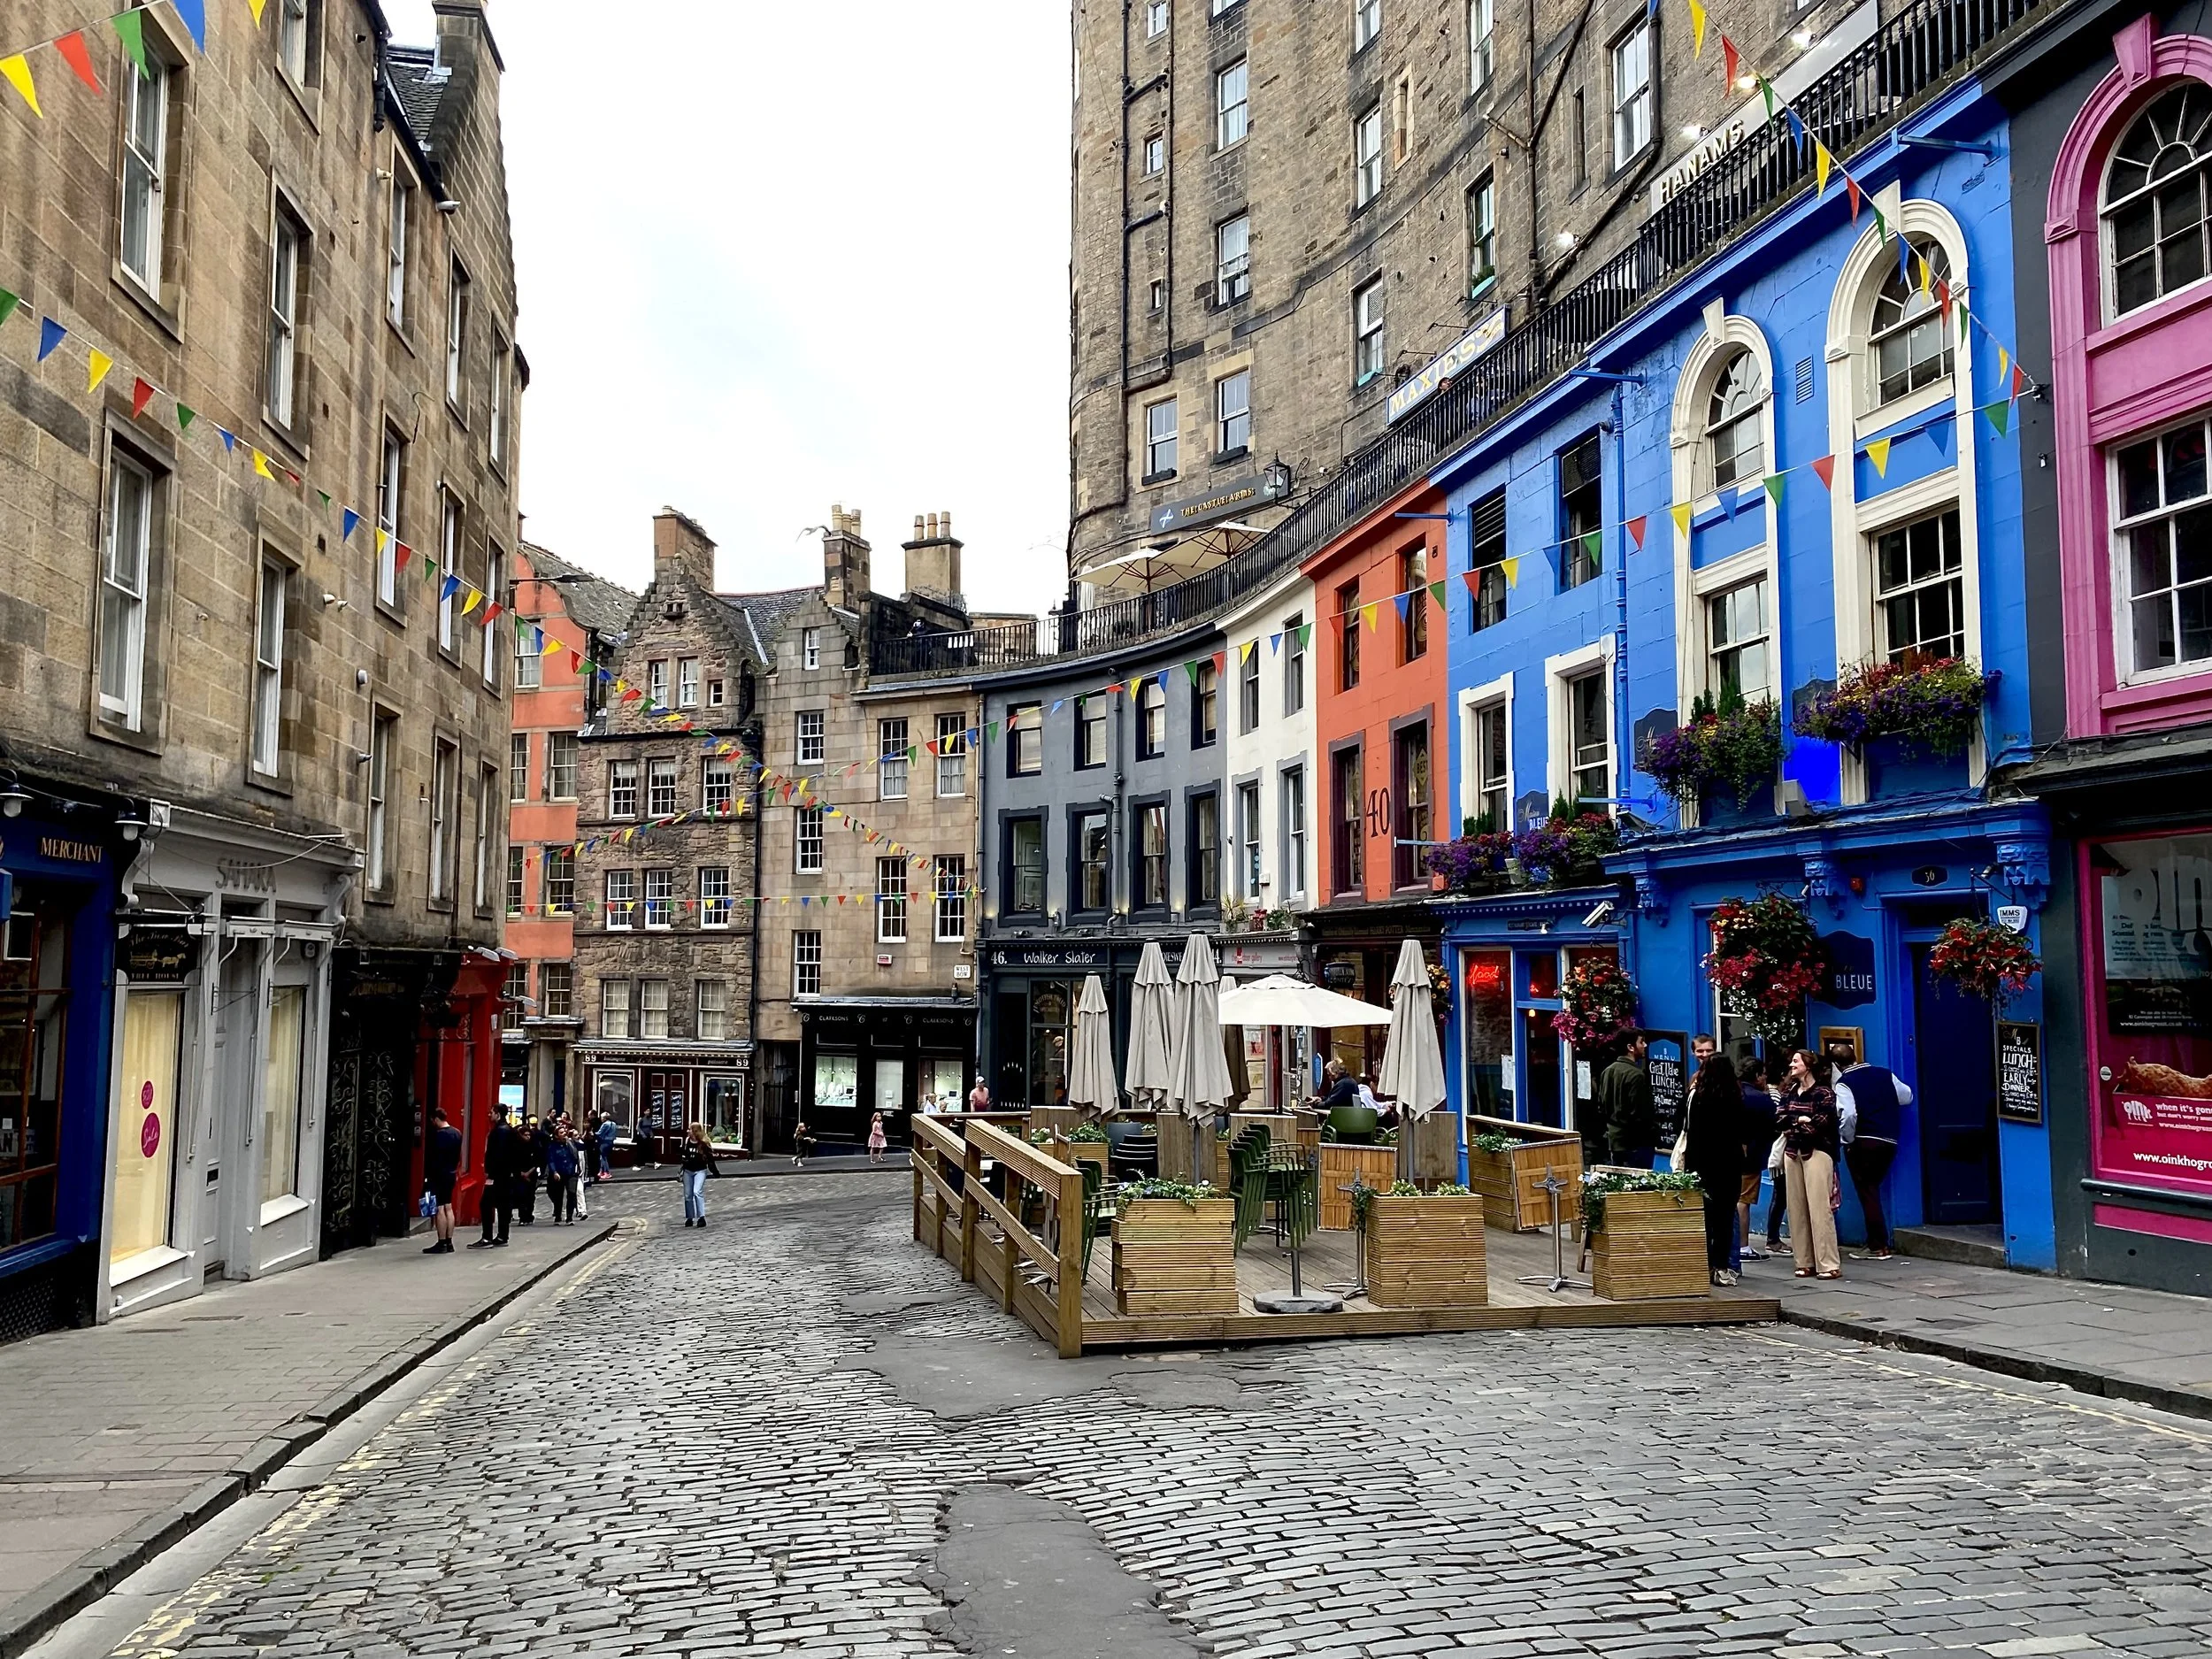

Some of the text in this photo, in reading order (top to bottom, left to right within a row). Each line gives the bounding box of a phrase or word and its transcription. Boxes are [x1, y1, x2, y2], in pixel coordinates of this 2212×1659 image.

[1661, 119, 1745, 204] HANAMS
[1180, 488, 1256, 518] THE CASTLE ARMS
[1366, 787, 1391, 838] 40
[41, 837, 104, 864] MERCHANT
[215, 857, 277, 894] SAHARA
[990, 950, 1096, 964] 46. Walker Slater
[1470, 964, 1499, 985] food
[1835, 974, 1873, 990] BLEUE
[2002, 1044, 2032, 1054] SPECIALS
[585, 1054, 597, 1063] 89
[736, 1058, 749, 1067] 89
[2002, 1052, 2034, 1070] LUNCH
[1651, 1074, 1676, 1089] LUNCH
[2003, 1071, 2029, 1087] EARLY
[2001, 1082, 2033, 1094] DINNER
[2155, 1102, 2212, 1116] when it's gon
